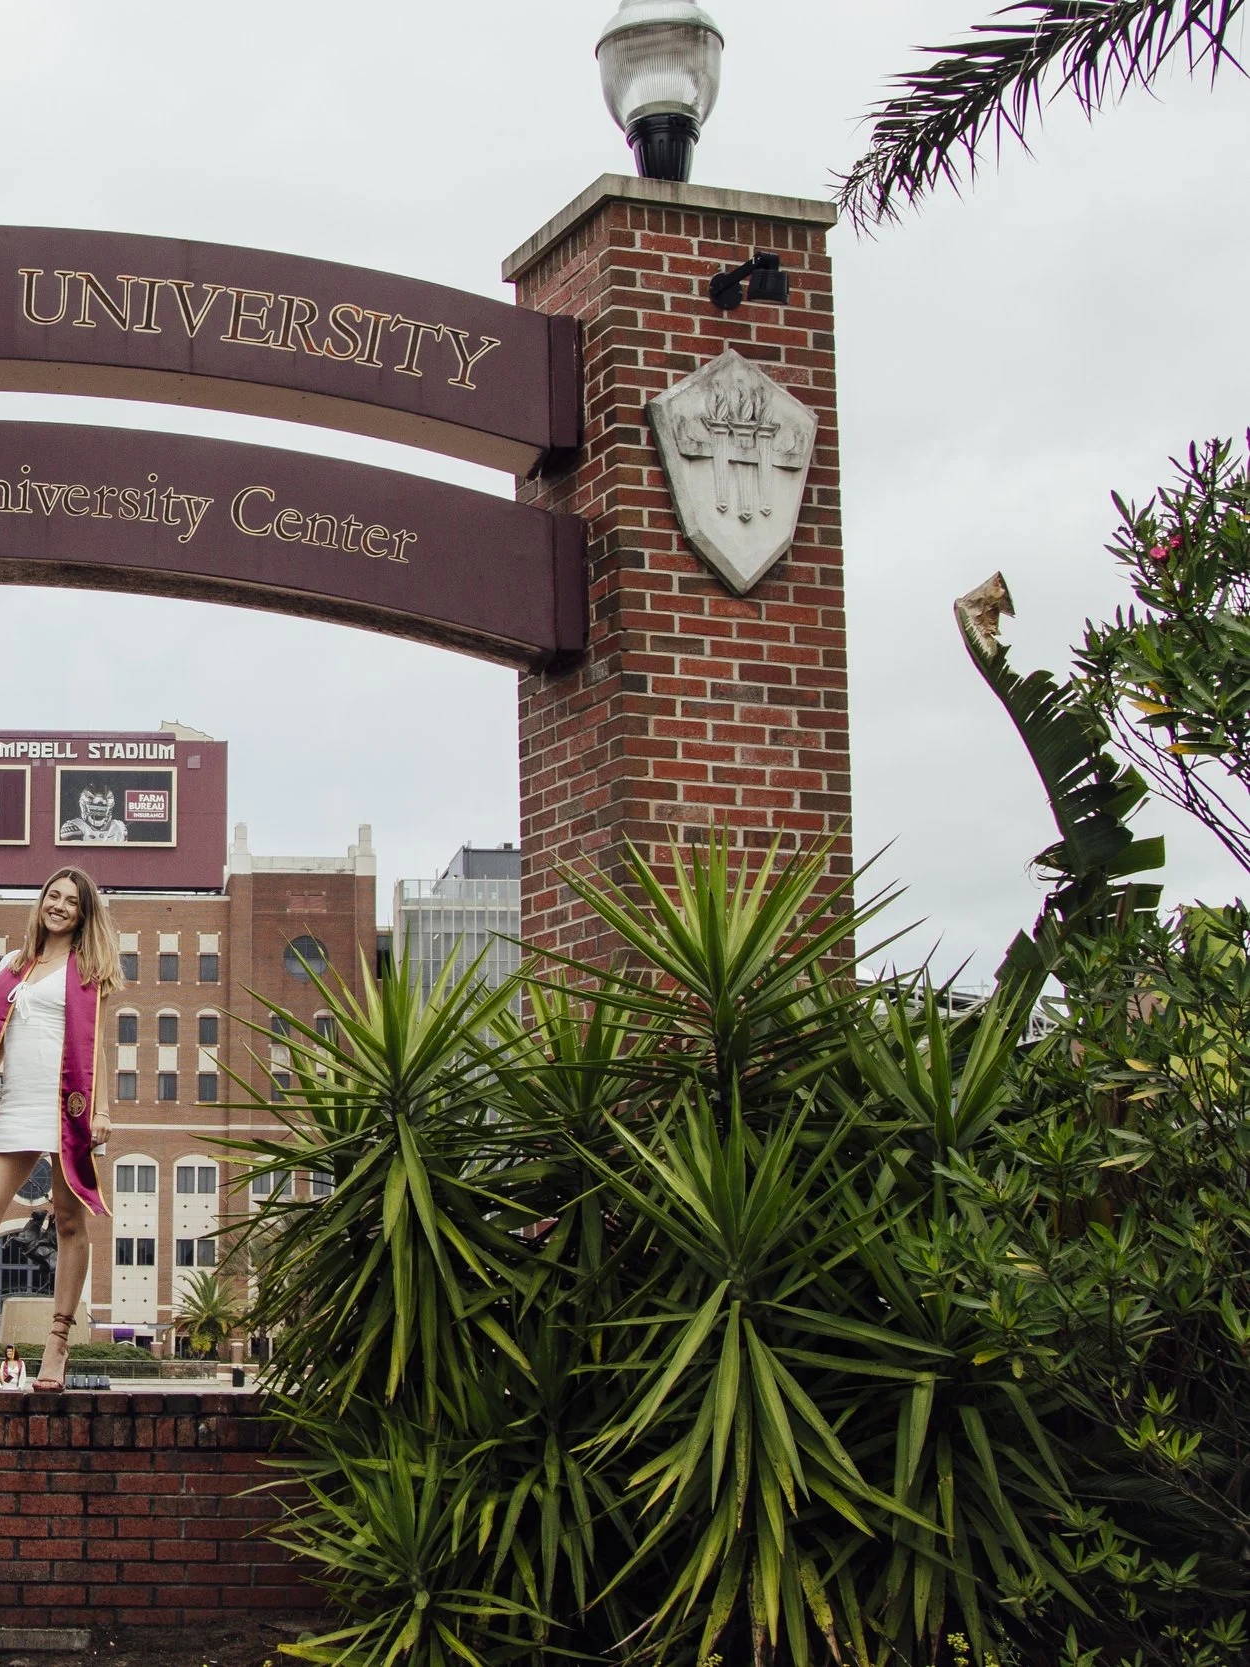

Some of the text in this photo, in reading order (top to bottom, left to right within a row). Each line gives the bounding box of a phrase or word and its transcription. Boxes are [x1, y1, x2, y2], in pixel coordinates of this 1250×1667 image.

[18, 268, 501, 390] UNIVERSITY
[230, 485, 418, 564] Center
[88, 742, 176, 760] STADIUM
[128, 802, 165, 810] BUREAU
[138, 793, 165, 803] FARM
